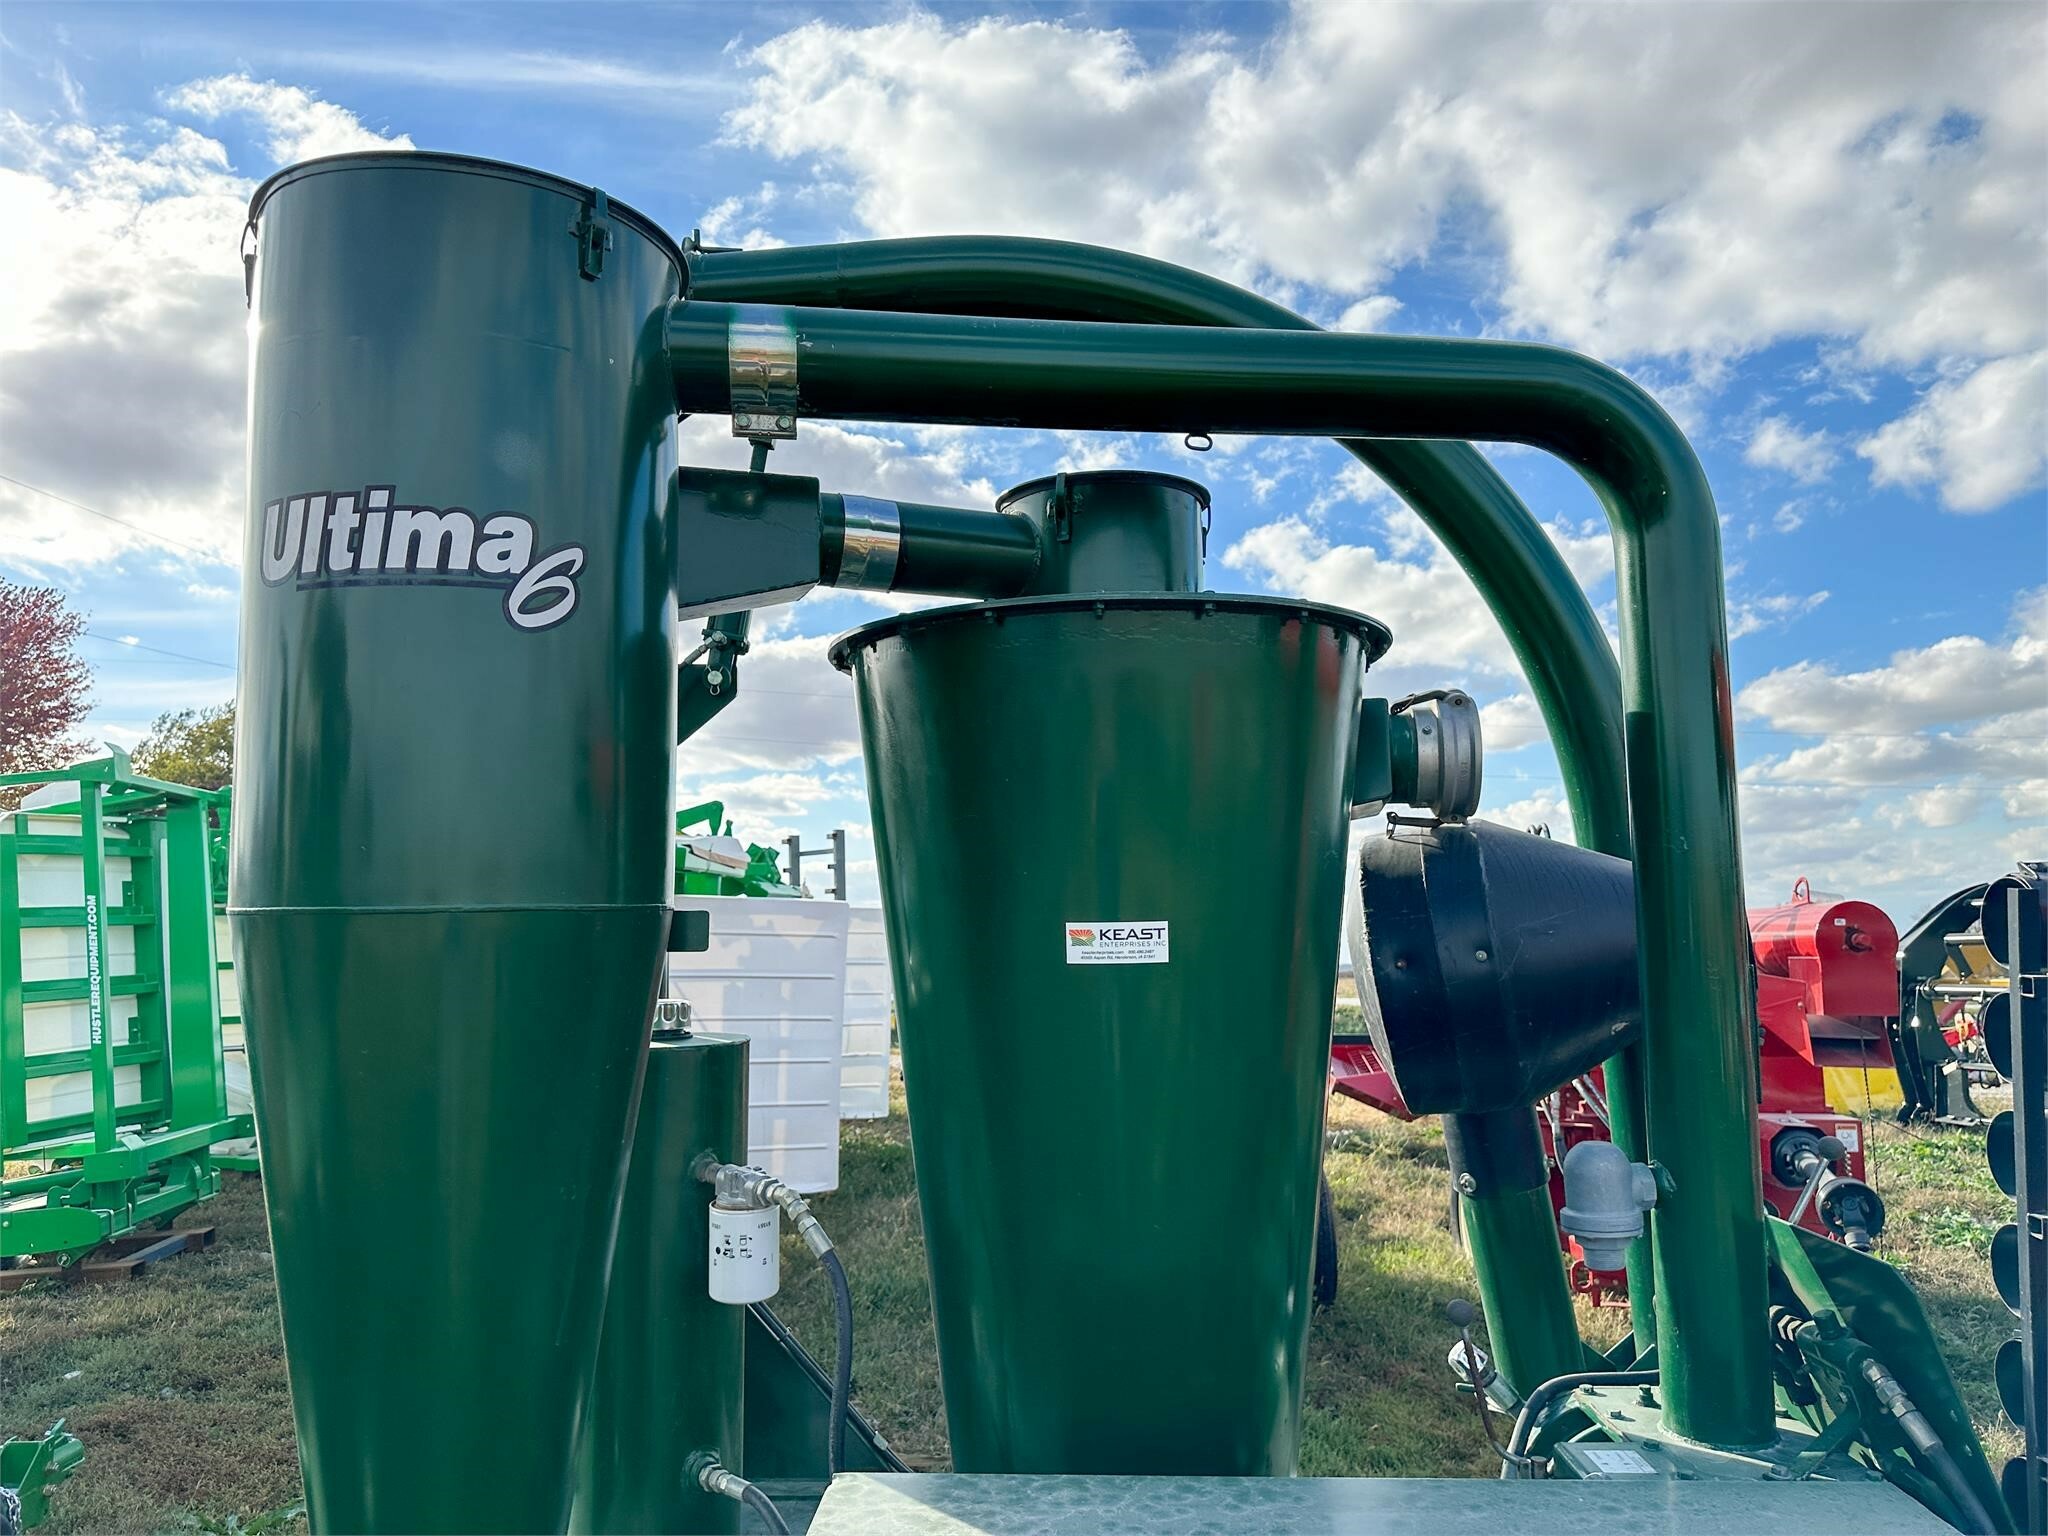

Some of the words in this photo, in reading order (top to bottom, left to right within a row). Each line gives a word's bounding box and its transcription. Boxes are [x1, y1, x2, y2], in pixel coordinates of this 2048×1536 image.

[261, 487, 535, 585] Ultima
[506, 545, 585, 630] 6
[87, 895, 102, 1044] HUSTLEREQUIPMENT.COM
[1099, 928, 1166, 940] KEAST
[1099, 940, 1151, 948] ENTERPRISES
